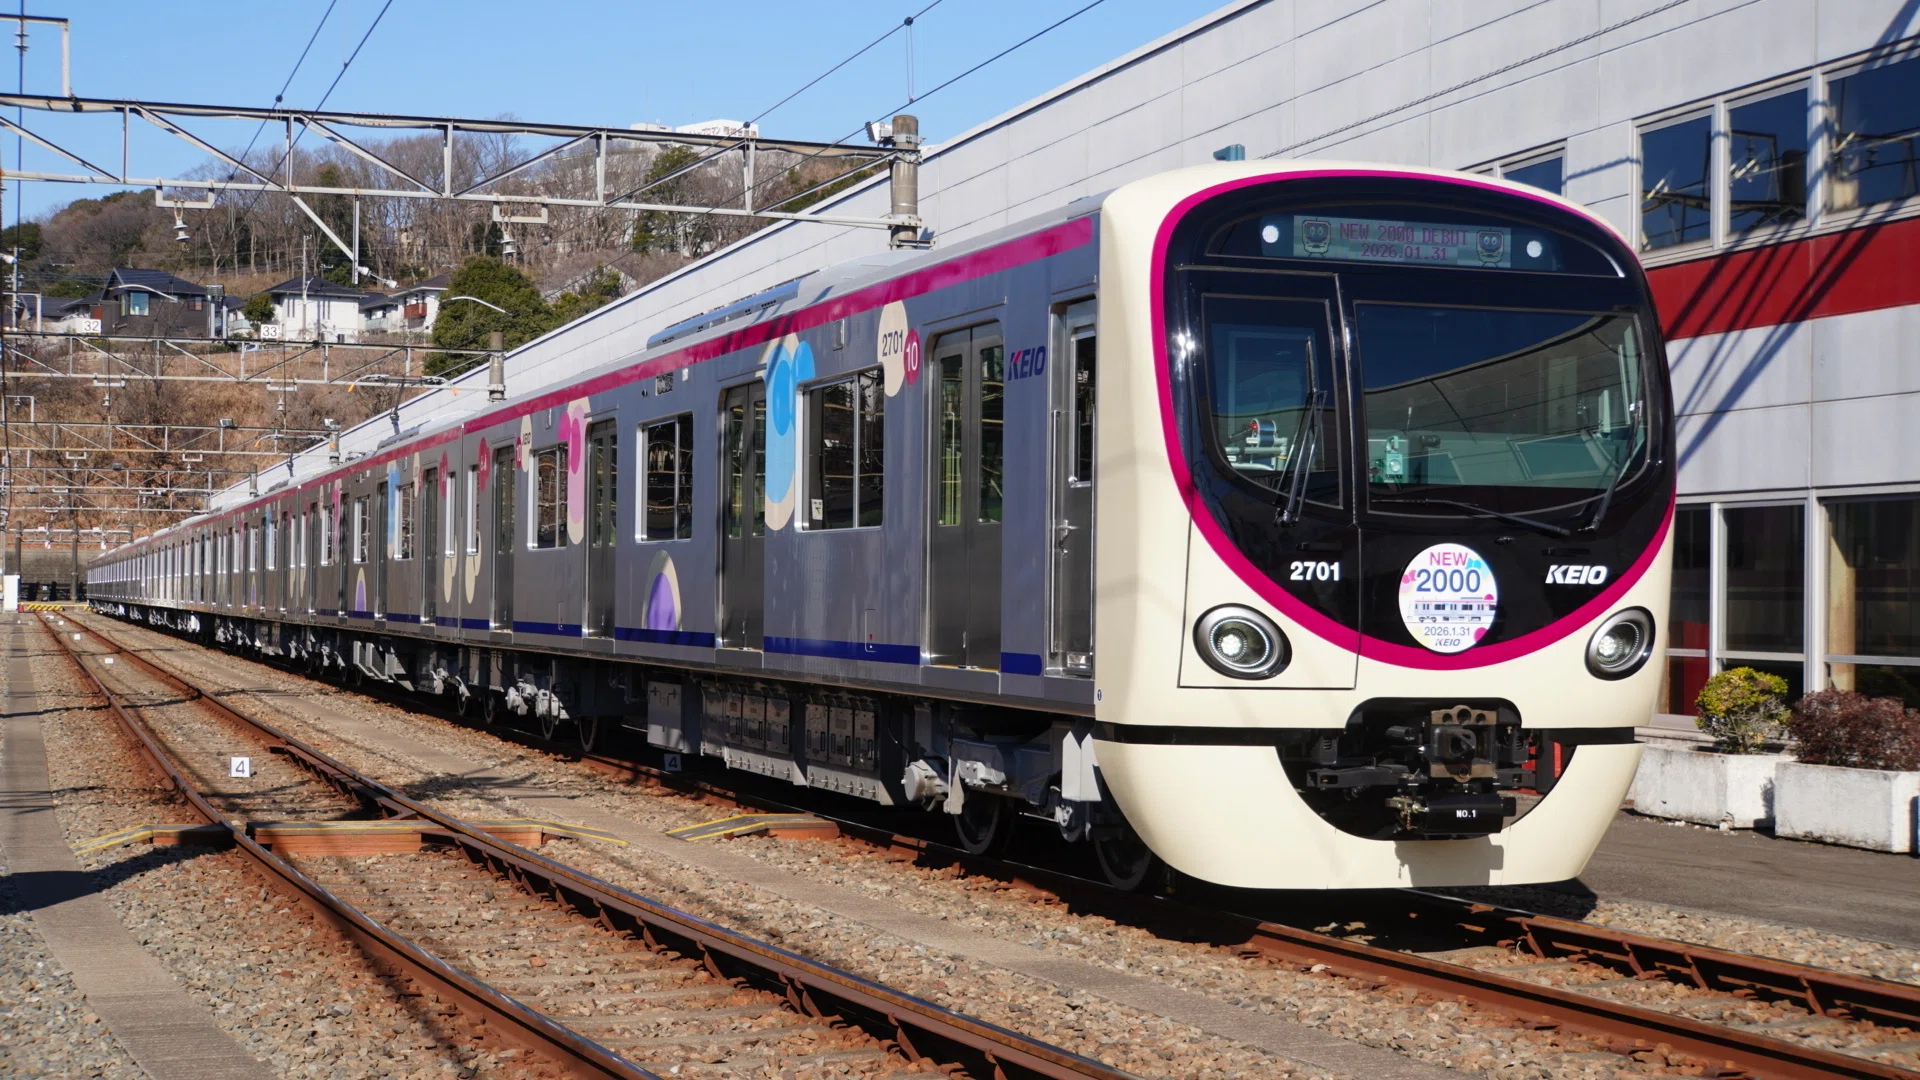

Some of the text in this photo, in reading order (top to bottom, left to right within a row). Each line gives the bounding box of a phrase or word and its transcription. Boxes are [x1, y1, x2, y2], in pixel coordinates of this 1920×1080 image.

[1339, 222, 1469, 246] NEW 2000 DEBUT
[1361, 243, 1448, 261] 2026.01.31
[84, 320, 99, 331] 32
[263, 326, 277, 337] 33
[882, 329, 903, 357] 2701
[906, 341, 918, 371] 10
[1007, 345, 1046, 381] KEIO
[1429, 552, 1468, 566] NEW
[1290, 561, 1341, 581] 2701
[1545, 564, 1608, 585] KEIO
[1416, 568, 1481, 593] 2000
[1424, 626, 1471, 636] 2026.1.31
[1435, 638, 1461, 646] KEIO
[235, 760, 245, 774] 4
[668, 756, 678, 769] 4
[1456, 809, 1477, 818] NO.1
